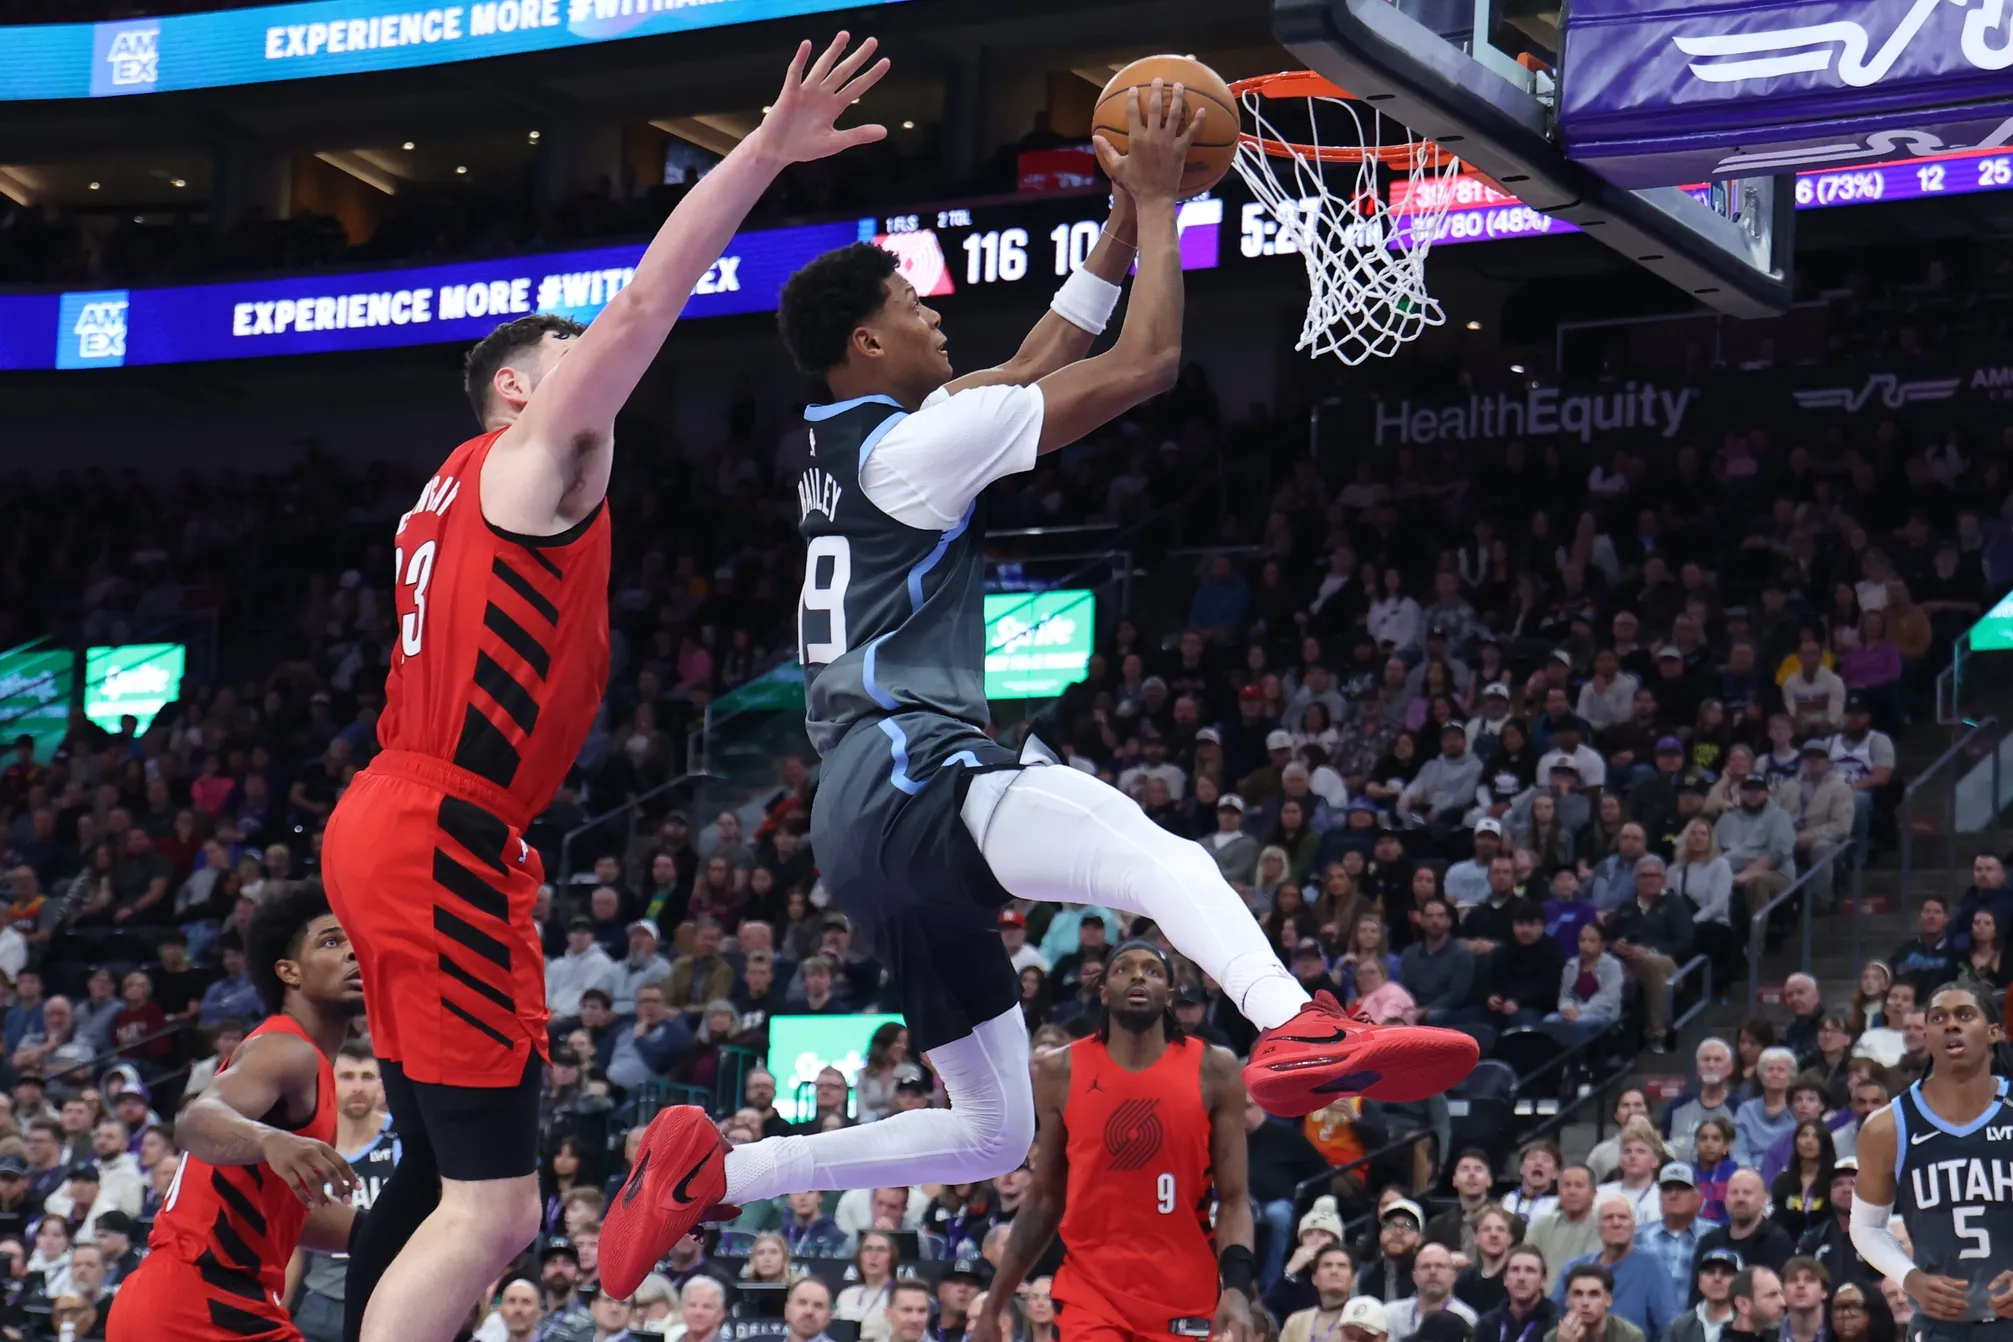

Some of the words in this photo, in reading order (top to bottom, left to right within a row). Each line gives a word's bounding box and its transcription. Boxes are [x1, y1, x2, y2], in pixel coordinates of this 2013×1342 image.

[107, 28, 160, 61] AM
[265, 8, 463, 60] EXPERIENCE
[470, 0, 560, 37] MORE
[112, 57, 159, 85] EX
[1817, 171, 1885, 206] (73%)
[1917, 164, 1945, 192] 12
[1978, 158, 2012, 187] 25
[1486, 205, 1552, 238] (48%)
[962, 227, 1029, 284] 116
[1050, 219, 1108, 276] 10
[74, 300, 130, 335] AM
[232, 286, 432, 337] EXPERIENCE
[438, 276, 530, 320] MORE
[79, 331, 127, 359] EX
[1374, 381, 1690, 447] HealthEquity
[396, 540, 436, 657] 3
[1157, 1173, 1176, 1215] 9
[1911, 1157, 2013, 1210] UTAH
[1952, 1205, 1991, 1260] 5
